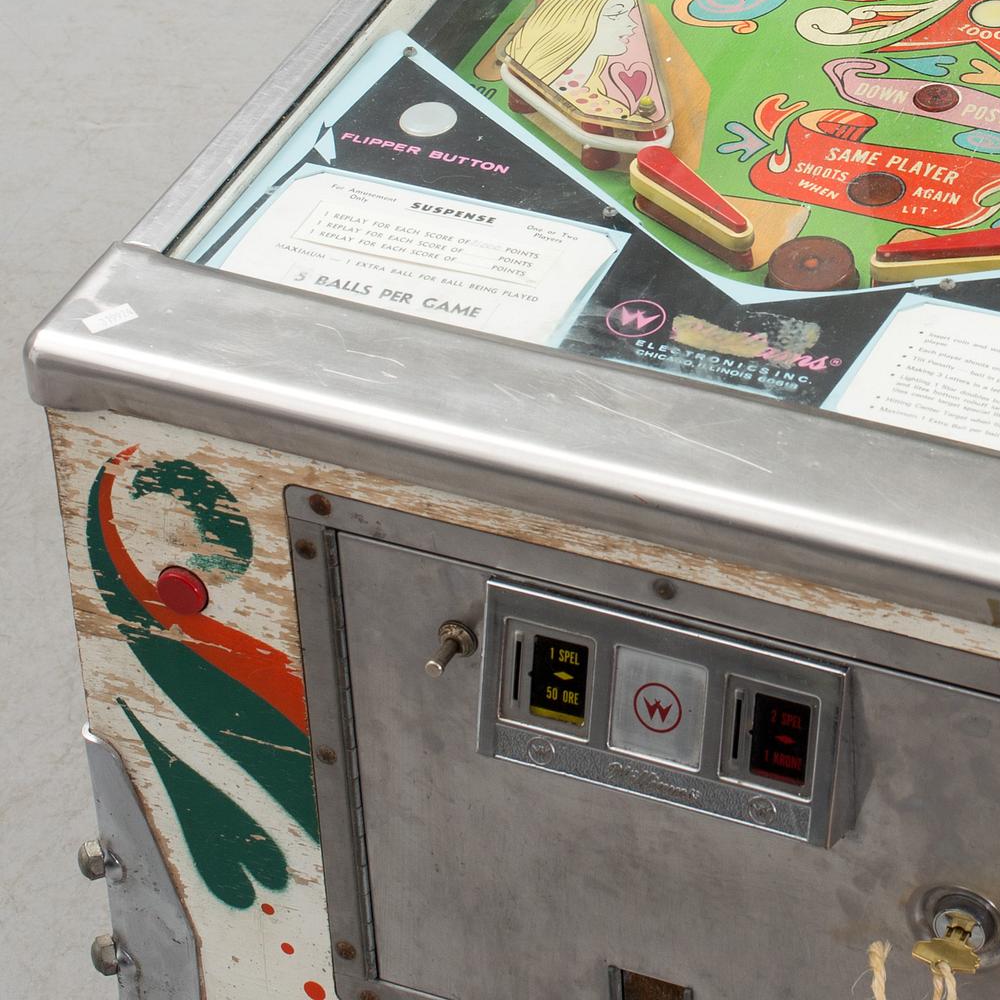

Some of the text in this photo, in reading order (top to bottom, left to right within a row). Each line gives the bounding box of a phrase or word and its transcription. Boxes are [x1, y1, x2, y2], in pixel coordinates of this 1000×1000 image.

[853, 82, 909, 105] DOWN
[341, 132, 510, 174] FLIPPER BUTTON
[824, 147, 960, 185] SAME PLAYER
[348, 188, 398, 202] Amusement
[349, 193, 368, 203] Only
[794, 162, 961, 205] SHOOTS AGAIN
[797, 179, 927, 215] WHEN LIT
[410, 202, 497, 224] SUSPENSE
[326, 222, 361, 233] REPLAY
[365, 230, 383, 238] FOR
[388, 234, 414, 244] EACH
[418, 240, 447, 251] SCORE
[498, 256, 533, 268] POINTS
[334, 213, 369, 224] REPLAY
[372, 221, 391, 229] FOR
[394, 226, 421, 235] EACH
[424, 231, 454, 242] SCORE
[505, 247, 540, 259] POINTS
[526, 224, 543, 232] One
[562, 232, 579, 241] Two
[533, 233, 563, 243] Players
[275, 242, 326, 259] MAXIMUM
[355, 261, 386, 272] EXTRA
[390, 269, 414, 278] BALL
[418, 274, 436, 282] FOR
[441, 278, 464, 287] BALL
[469, 283, 499, 294] BEING
[502, 290, 538, 302] PLAYED
[320, 231, 354, 242] REPLAY
[359, 239, 377, 247] FOR
[380, 244, 407, 253] EACH
[410, 249, 440, 259] SCORE
[491, 265, 526, 277] POINTS
[314, 275, 373, 296] BALLS
[379, 288, 413, 305] PER
[422, 297, 482, 318] GAME
[635, 339, 770, 374] ELECTRONICS
[775, 371, 812, 385] INC.
[550, 647, 580, 666] 1 SPEL
[546, 686, 558, 700] 50
